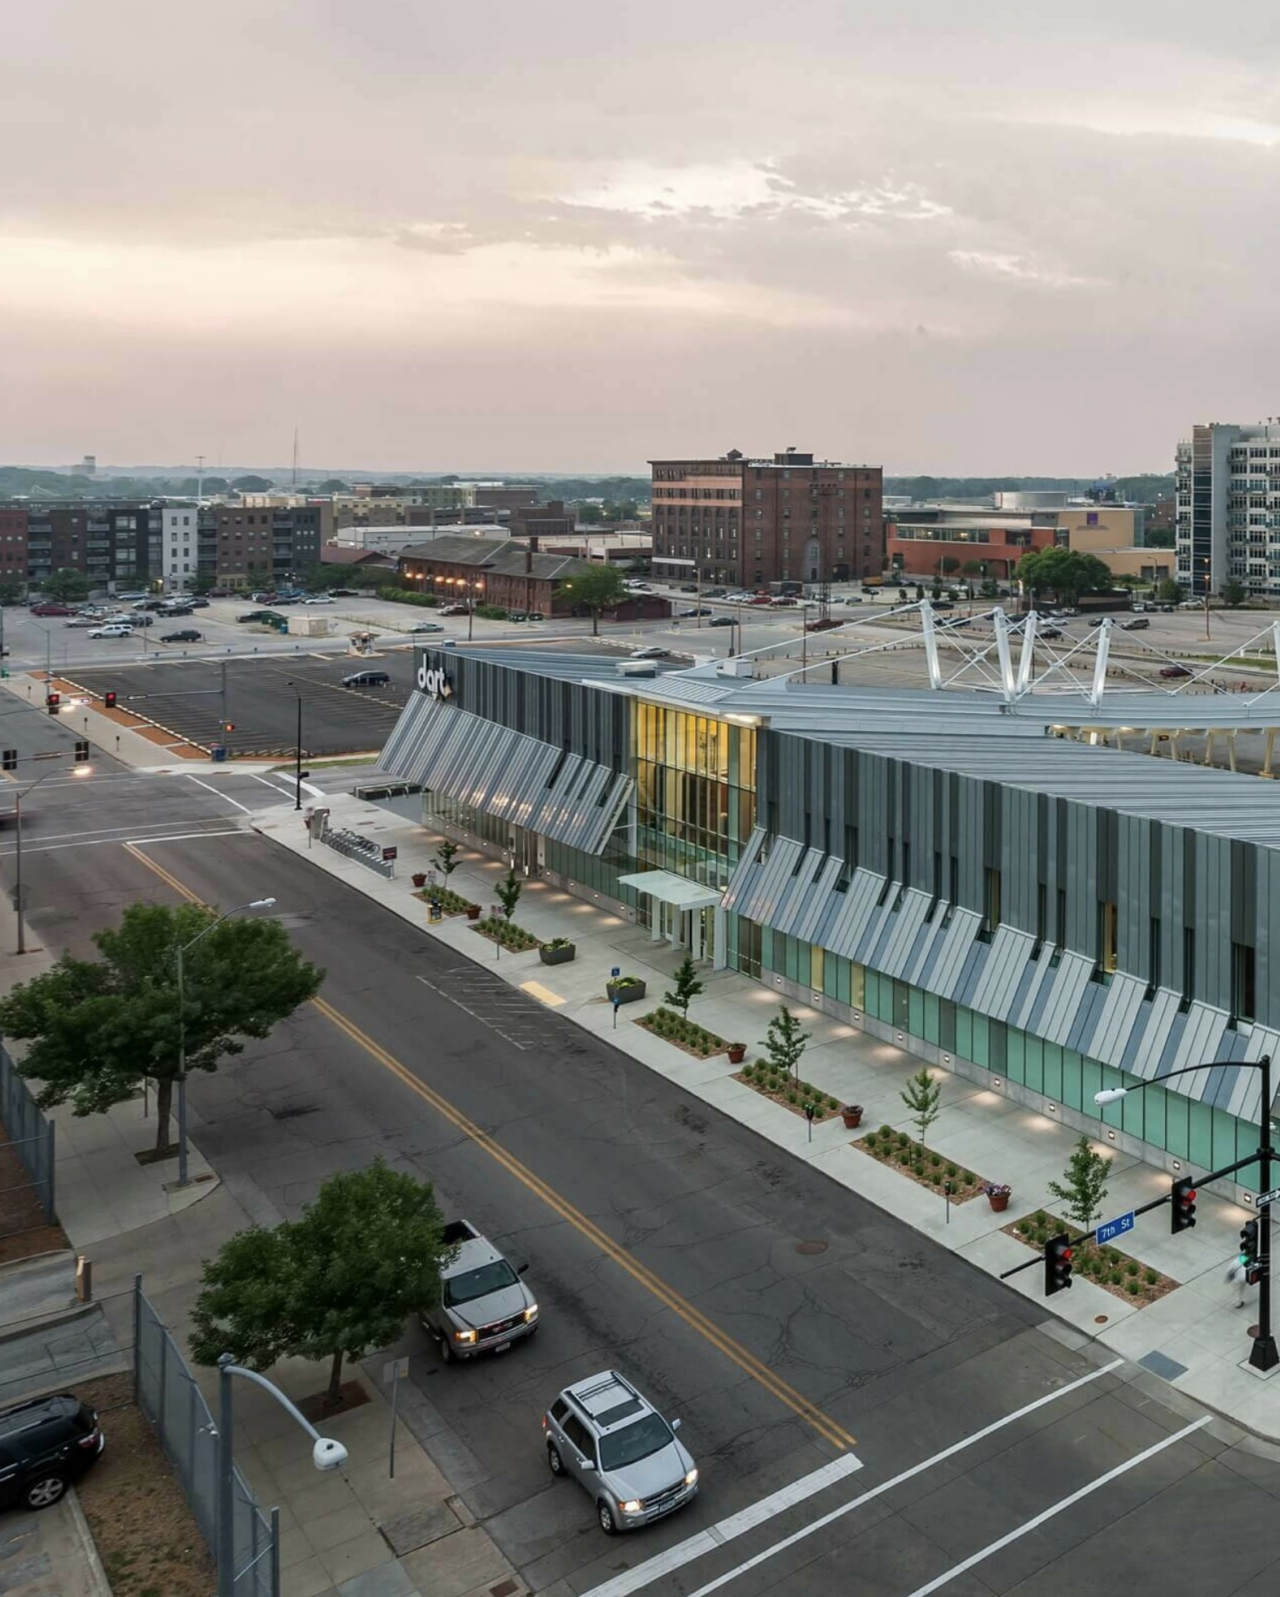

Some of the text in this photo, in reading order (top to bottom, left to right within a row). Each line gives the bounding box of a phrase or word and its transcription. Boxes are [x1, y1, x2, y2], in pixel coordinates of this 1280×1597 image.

[418, 653, 446, 697] dart
[1101, 1218, 1130, 1239] 7th St
